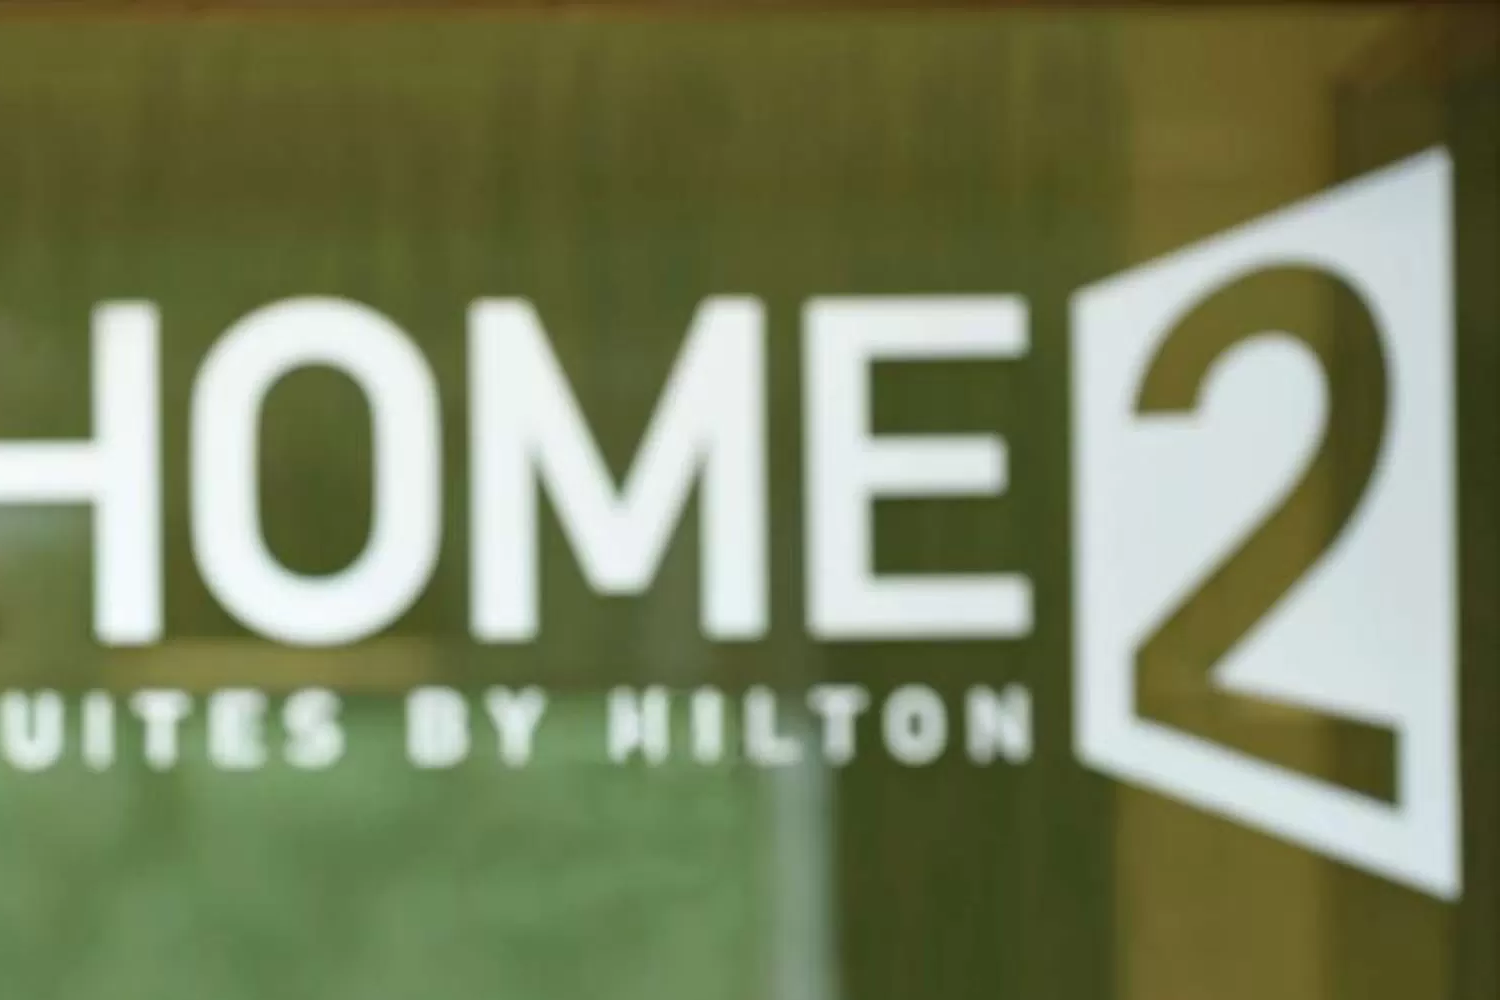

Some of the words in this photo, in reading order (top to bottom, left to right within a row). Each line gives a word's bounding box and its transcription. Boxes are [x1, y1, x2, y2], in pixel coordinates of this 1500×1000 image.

[1131, 257, 1406, 813] 2
[406, 685, 550, 768] BY
[607, 684, 1036, 767] HILTON
